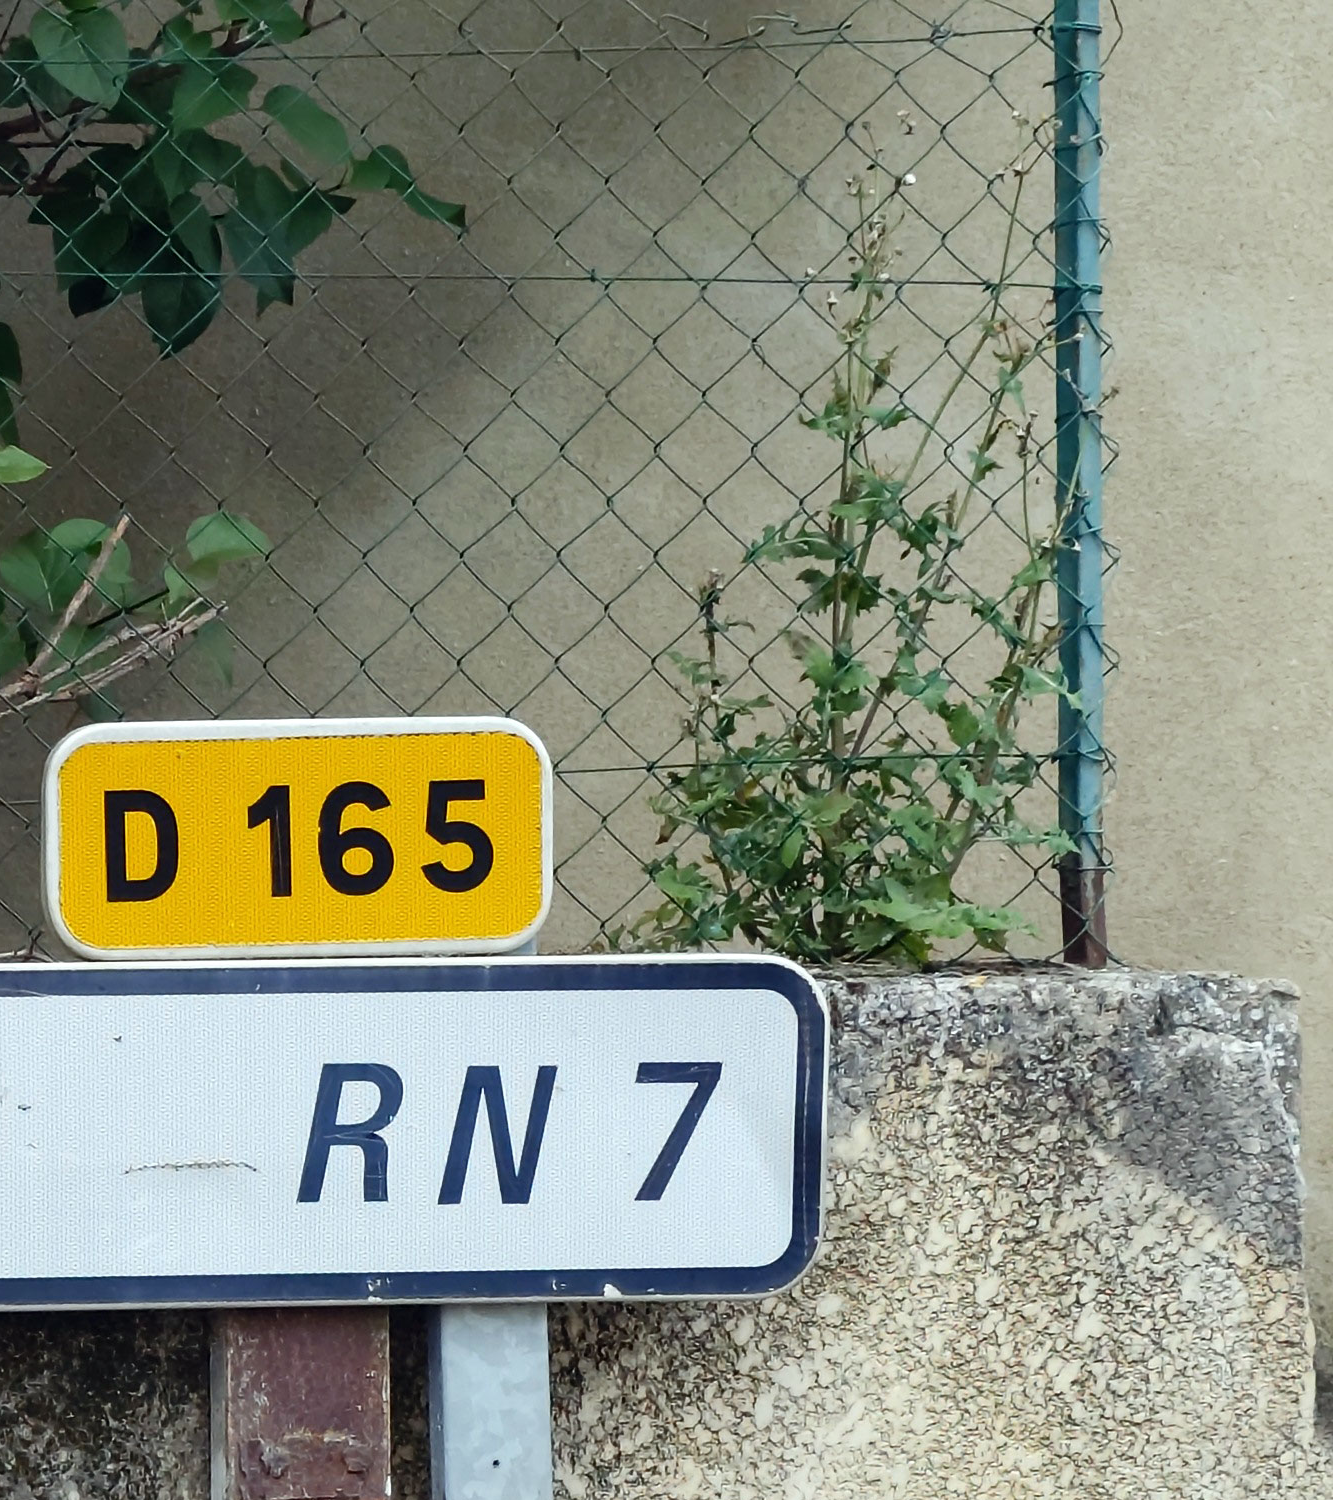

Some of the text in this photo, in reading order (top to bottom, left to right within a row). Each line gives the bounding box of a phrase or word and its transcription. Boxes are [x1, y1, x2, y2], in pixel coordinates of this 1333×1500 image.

[103, 778, 495, 904] D 165
[295, 1061, 560, 1207] RN
[633, 1060, 725, 1203] 7
